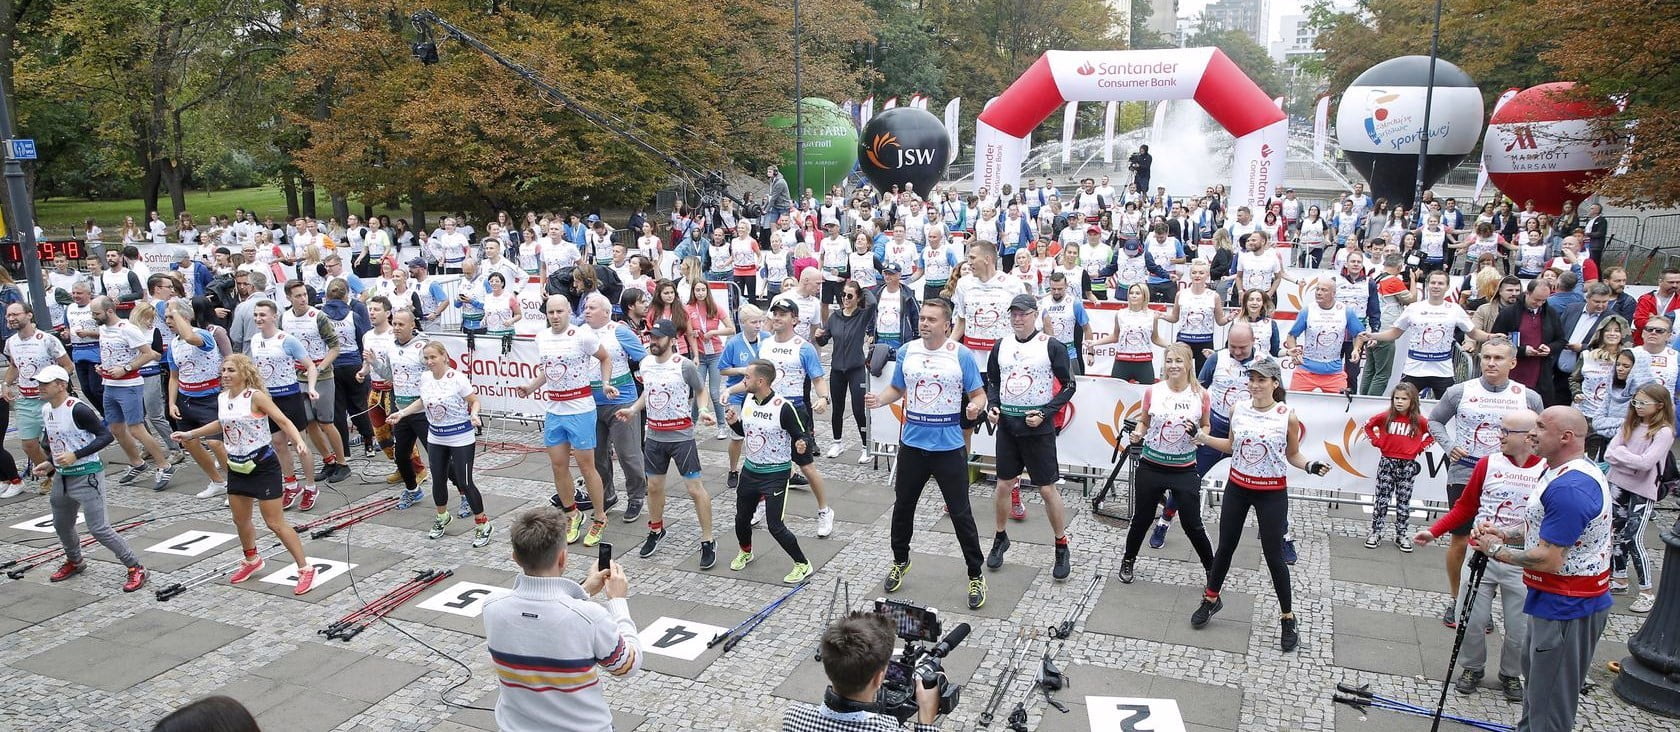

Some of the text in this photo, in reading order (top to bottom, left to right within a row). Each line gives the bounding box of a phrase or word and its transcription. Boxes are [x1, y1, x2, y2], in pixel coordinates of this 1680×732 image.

[1098, 63, 1178, 75] Santander
[1098, 77, 1176, 88] Consumer Bank
[1391, 121, 1450, 150] sportwej
[897, 149, 936, 169] JSW
[772, 347, 793, 355] onet
[1174, 402, 1190, 411] JSW
[752, 410, 773, 421] onet
[1387, 421, 1414, 437] WHA
[168, 535, 211, 551] 7
[444, 589, 491, 609] 5
[652, 625, 698, 648] 4
[1117, 704, 1154, 732] 2
